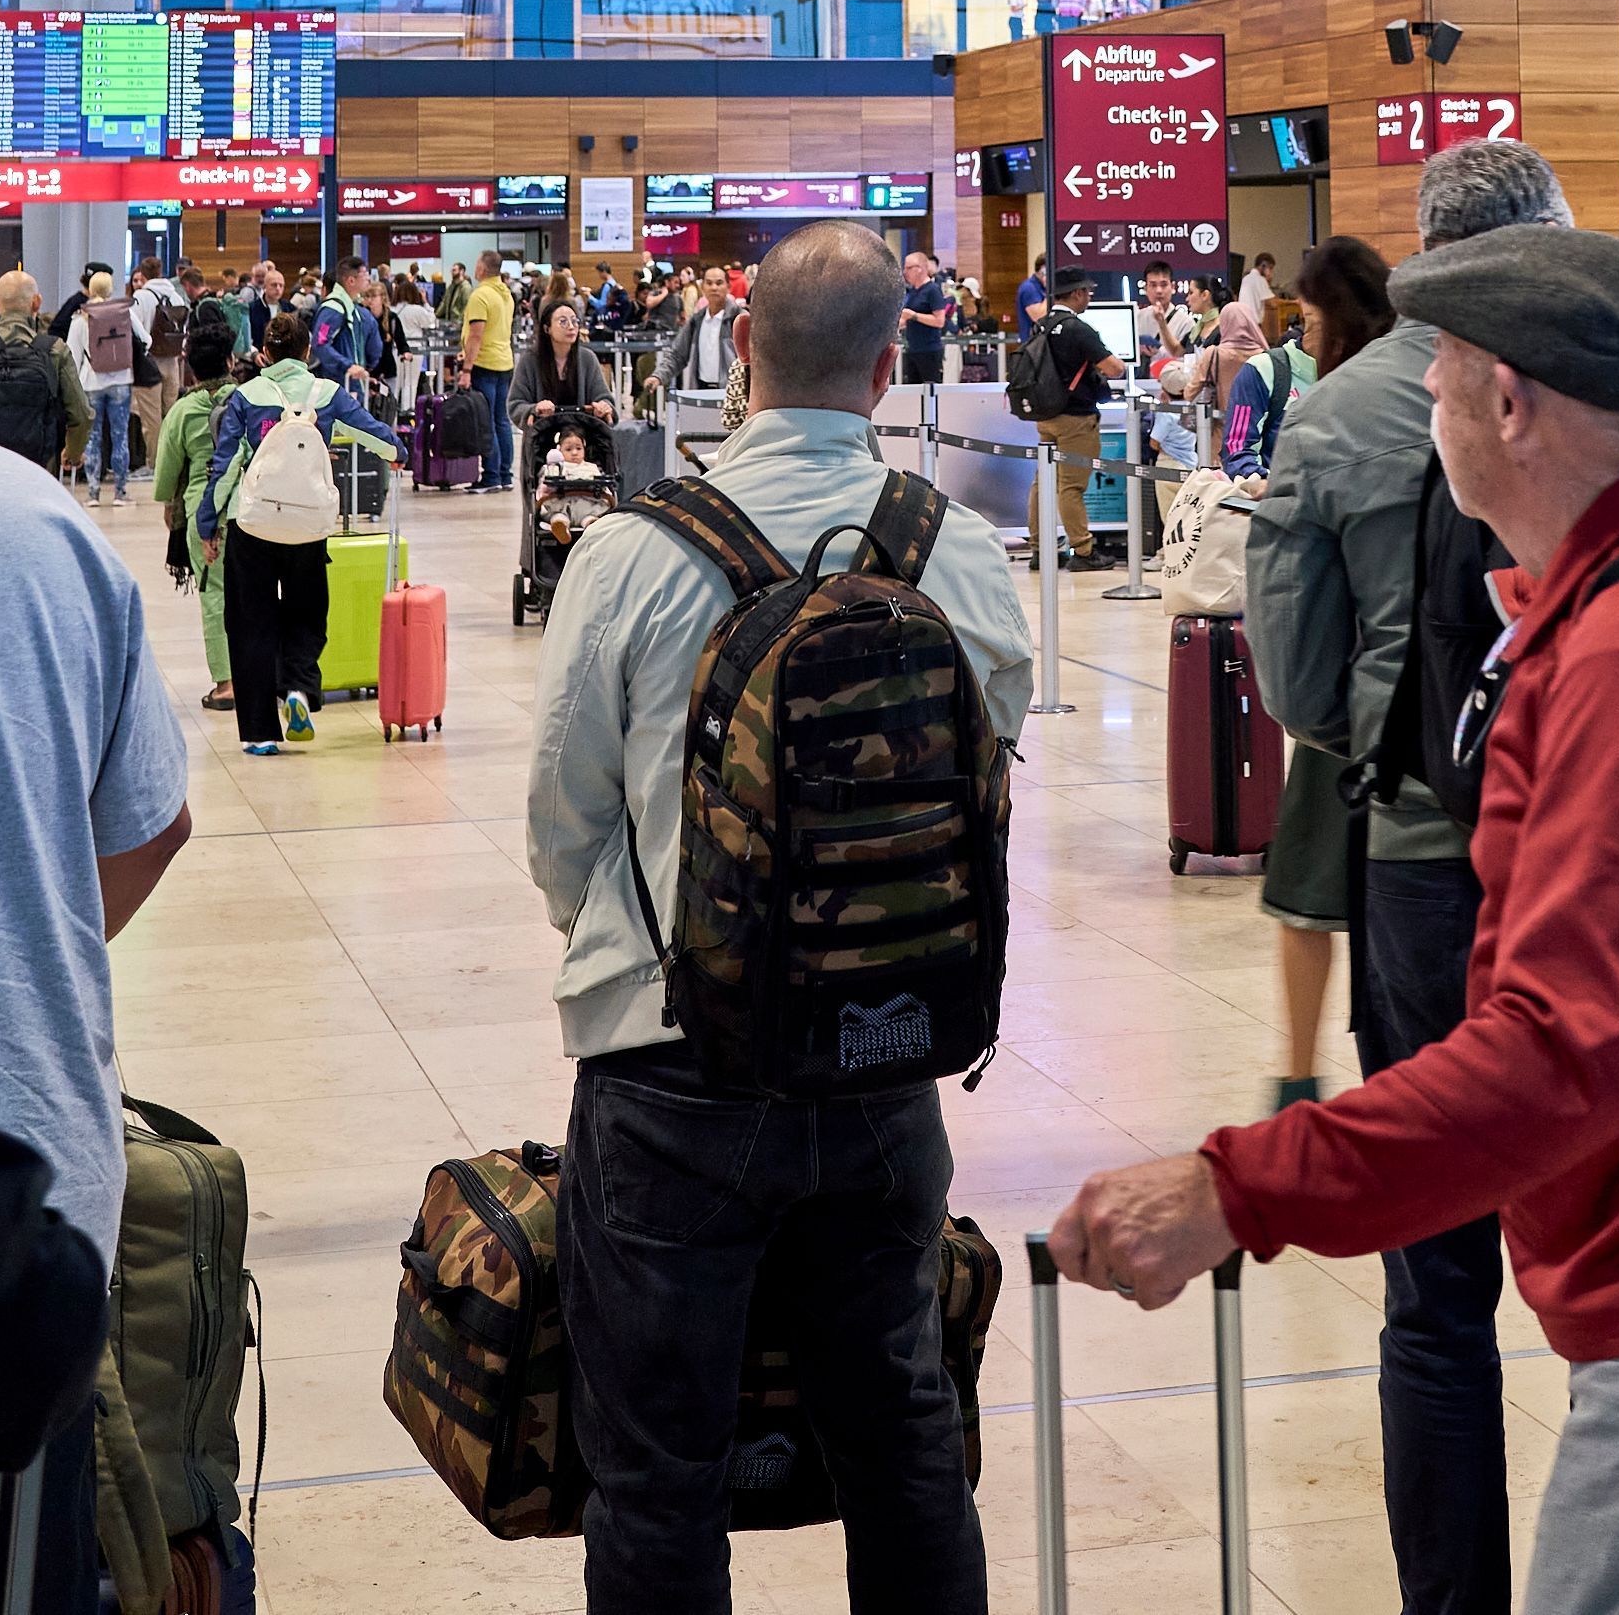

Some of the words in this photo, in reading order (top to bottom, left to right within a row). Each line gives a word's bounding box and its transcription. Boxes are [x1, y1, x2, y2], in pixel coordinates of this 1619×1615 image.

[183, 13, 210, 24] Abflug
[1094, 45, 1156, 68] Abflug
[1095, 67, 1165, 85] Departure
[1108, 105, 1186, 124] Check-in
[1440, 98, 1481, 112] Check-in
[1486, 98, 1516, 143] 2
[1409, 101, 1424, 150] 2
[179, 166, 250, 184] Check-in
[971, 150, 982, 187] 2
[1097, 161, 1175, 179] Check-in
[343, 188, 363, 200] Alle
[1128, 223, 1189, 238] Terminal
[1195, 231, 1214, 246] T2
[1140, 241, 1161, 253] 500
[1164, 243, 1175, 252] m
